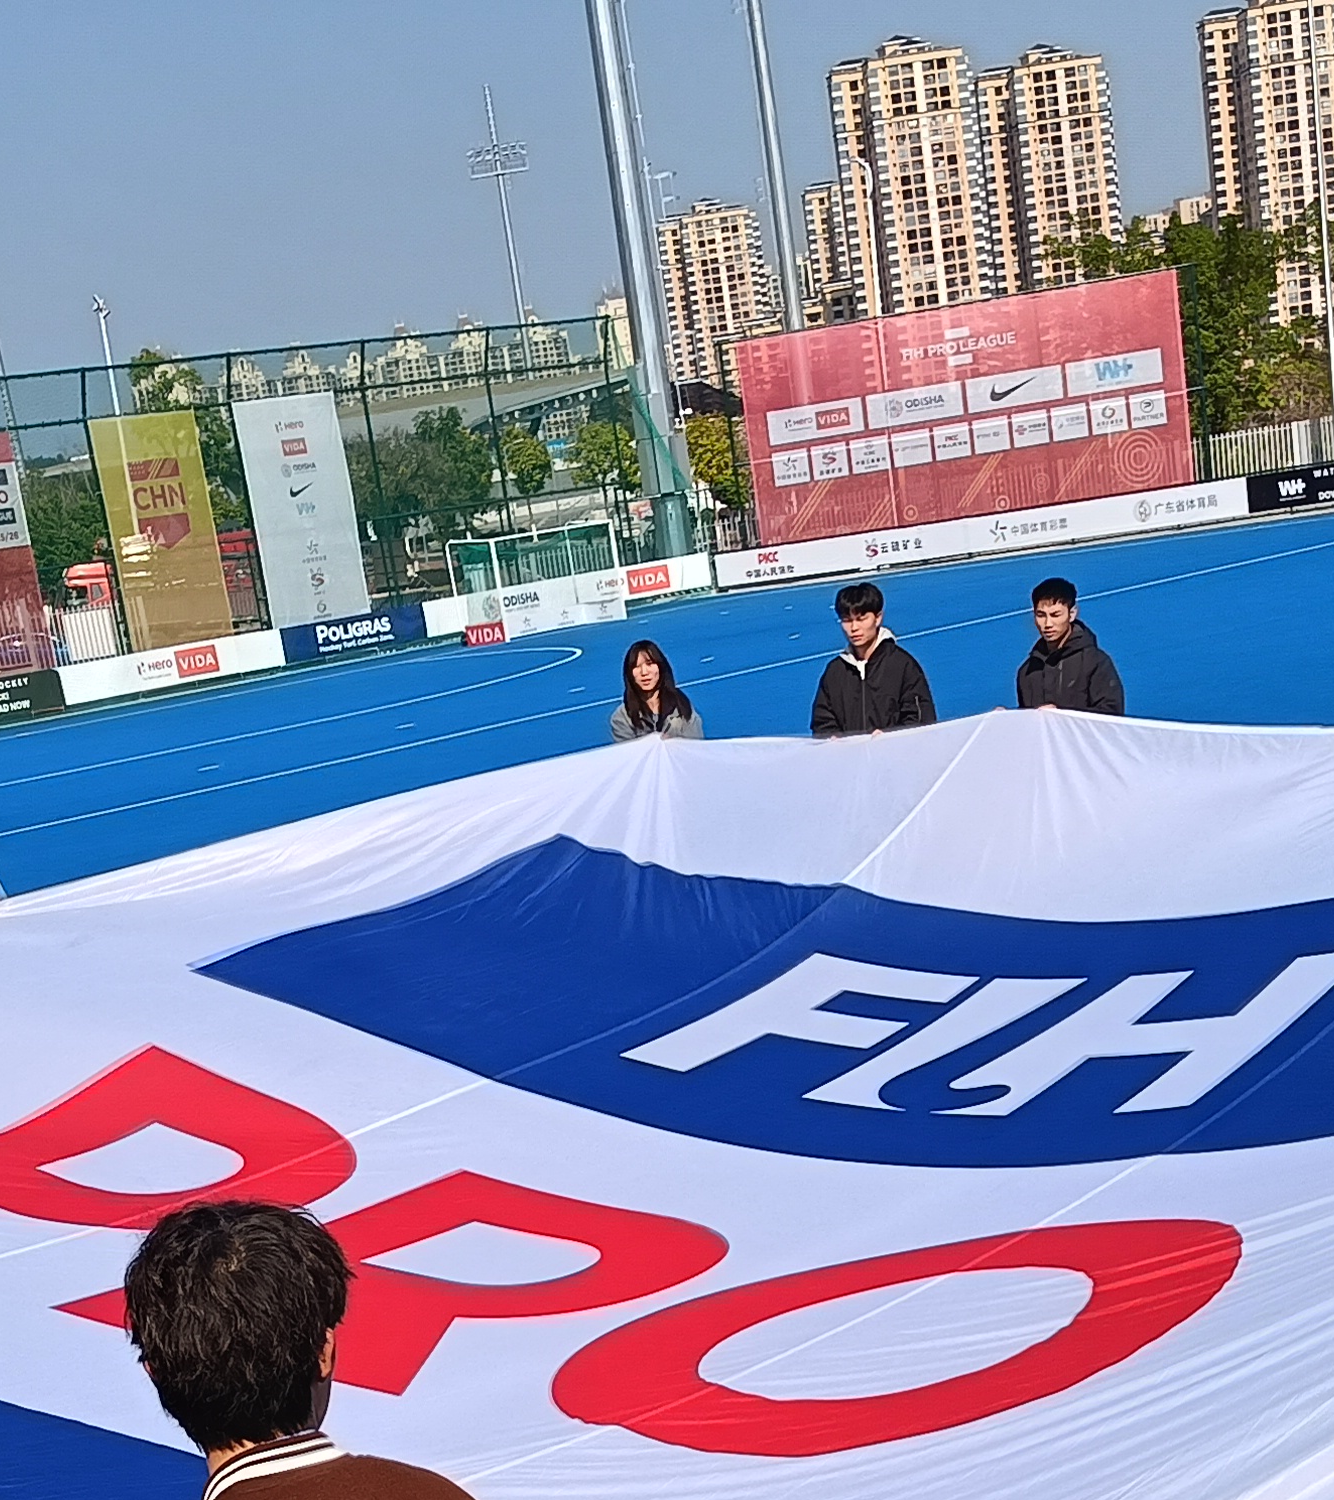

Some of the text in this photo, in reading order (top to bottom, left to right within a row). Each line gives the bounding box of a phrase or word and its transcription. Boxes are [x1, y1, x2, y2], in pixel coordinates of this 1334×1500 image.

[927, 342, 957, 357] PRO
[959, 332, 1016, 352] LEAGUE
[905, 395, 944, 408] ODISHA
[818, 413, 847, 424] VIDA
[284, 441, 305, 453] VIDA
[133, 482, 186, 510] CHN
[630, 571, 667, 588] VIDA
[503, 591, 540, 607] ODISHA
[316, 616, 392, 644] POLIGRAS
[467, 627, 503, 644] VIDA
[179, 653, 216, 671] VIDA
[10, 700, 30, 711] NOW
